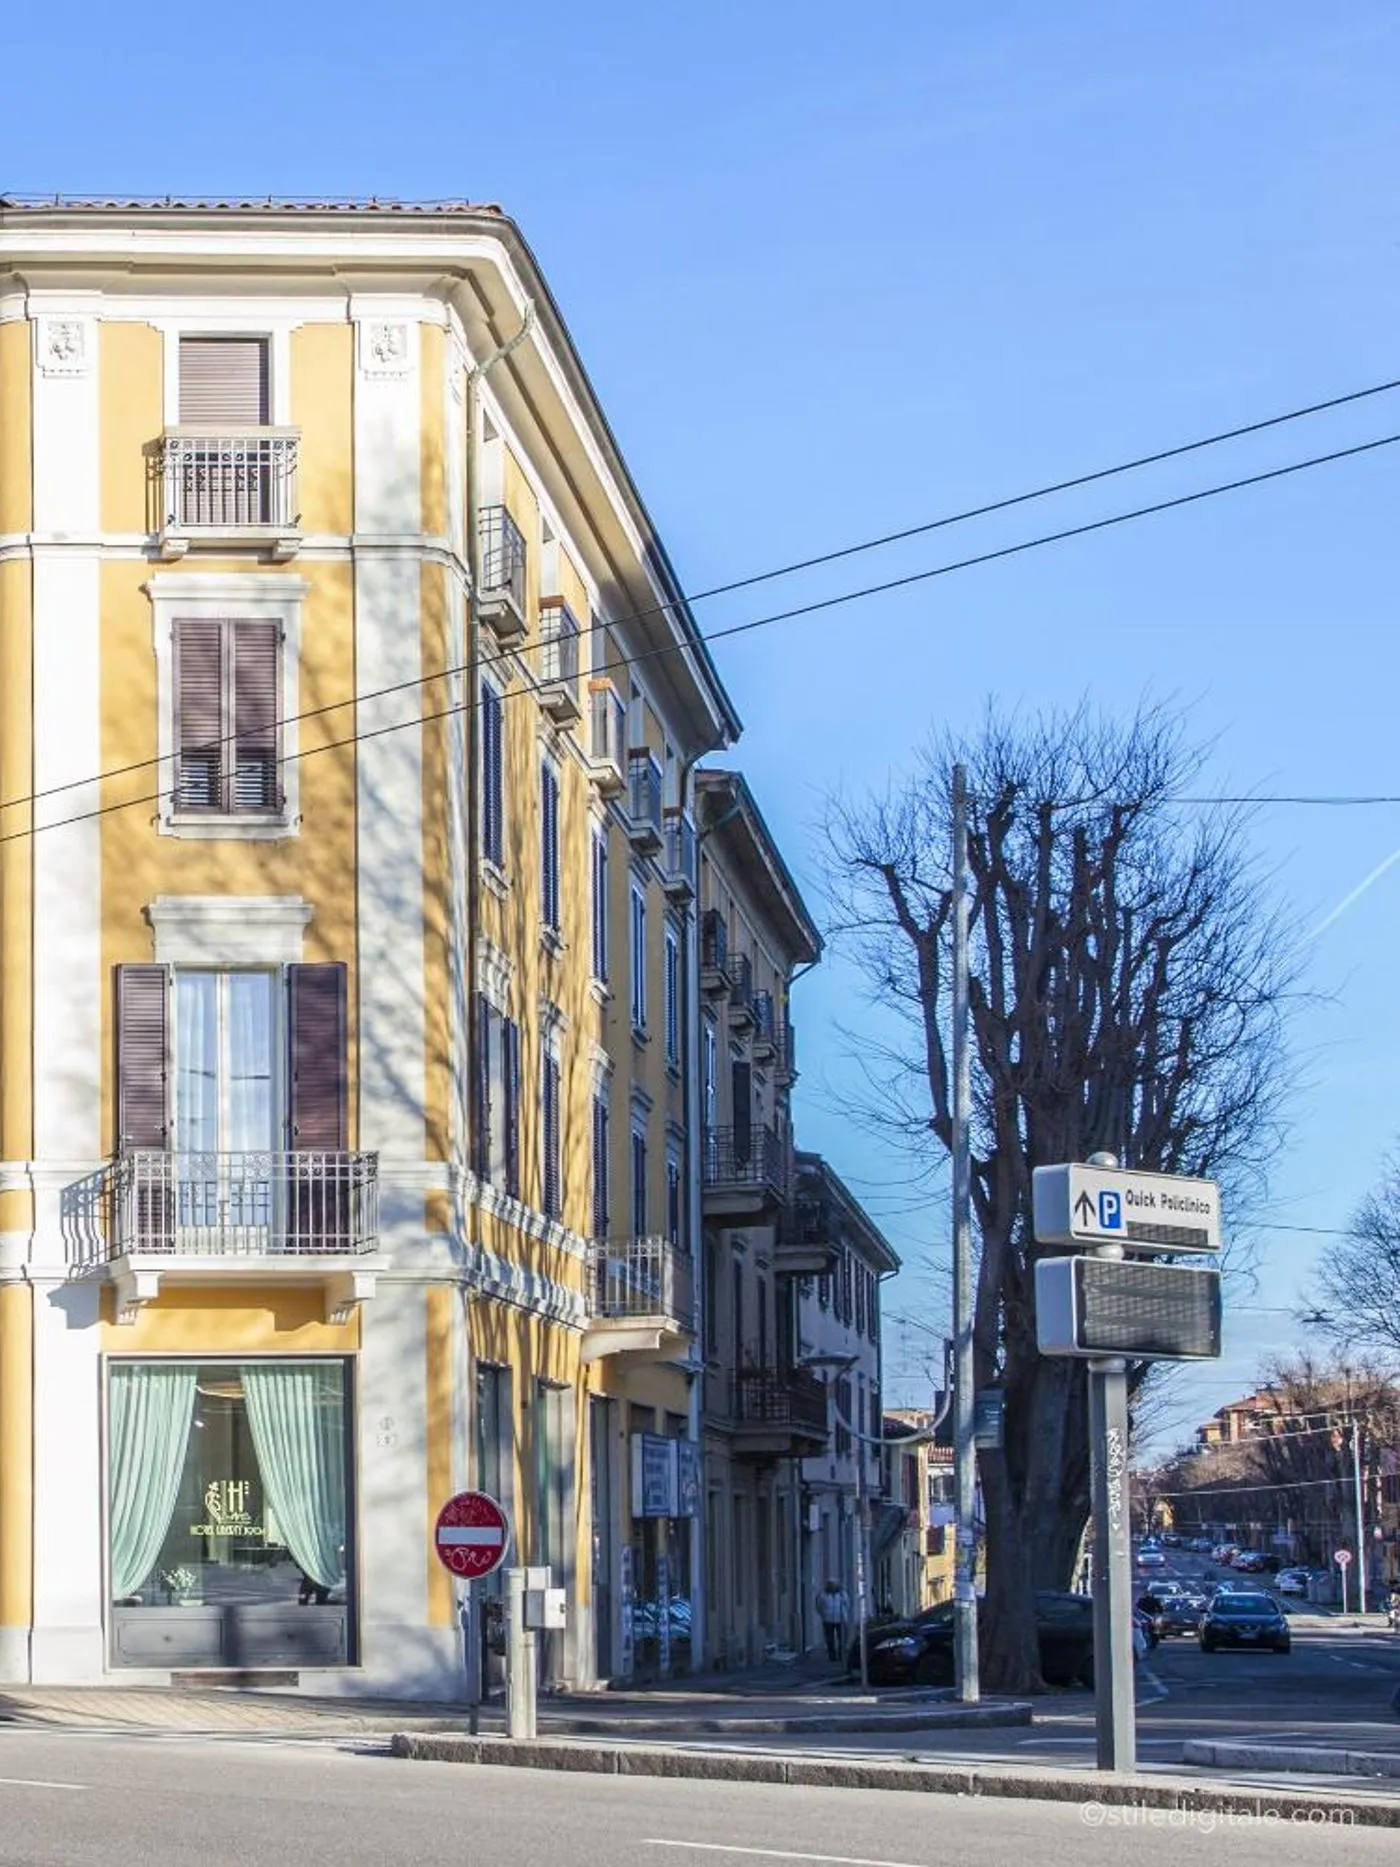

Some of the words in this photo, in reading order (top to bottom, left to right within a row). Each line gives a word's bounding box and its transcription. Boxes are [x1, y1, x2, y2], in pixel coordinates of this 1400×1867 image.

[1102, 1194, 1118, 1226] P
[1125, 1189, 1156, 1209] Quick
[1160, 1192, 1210, 1215] Policlinico
